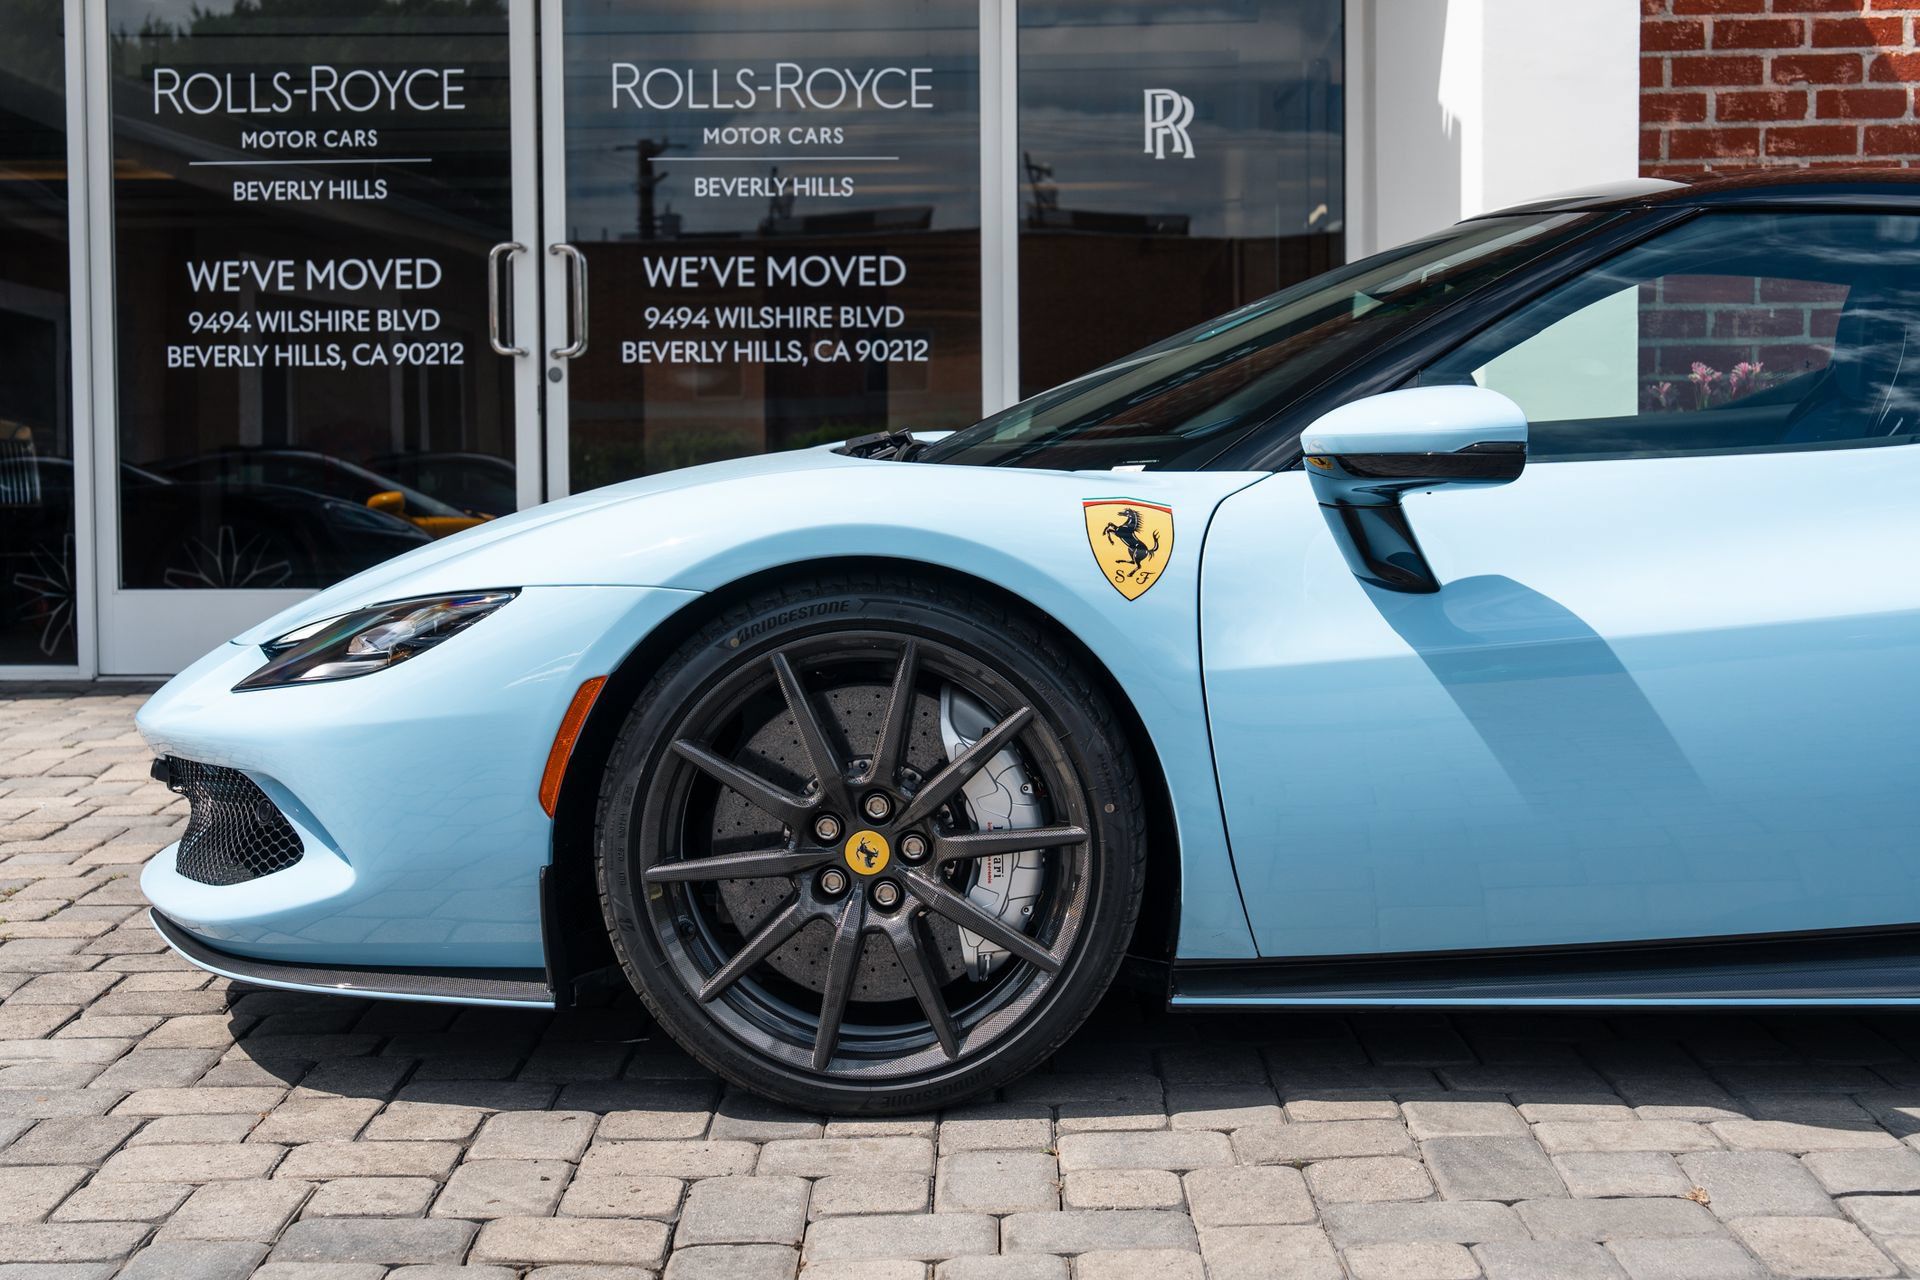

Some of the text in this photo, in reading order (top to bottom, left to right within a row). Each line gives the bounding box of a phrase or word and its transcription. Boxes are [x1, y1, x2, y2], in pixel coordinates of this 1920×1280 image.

[154, 65, 466, 115] ROLLS-ROYCE
[611, 62, 934, 110] ROLLS-ROYCE
[703, 126, 844, 145] MOTOR CARS
[1143, 88, 1196, 160] RR
[241, 129, 378, 149] MOTOR CARS
[233, 179, 388, 201] BEVERLY HILLS
[694, 176, 854, 198] BEVERLY HILLS
[187, 258, 442, 292] WE'VE MOVED
[643, 255, 906, 288] WE'VE MOVED
[188, 309, 441, 334] 9494 WILSHIRE BLVD
[643, 306, 905, 329] 9494 WILSHIRE BLVD
[167, 342, 464, 371] BEVERLY HILLS, CA 90212
[622, 339, 929, 367] BEVERLY HILLS, CA 90212
[1114, 569, 1156, 585] S F
[737, 599, 850, 643] BRIDGESTONE
